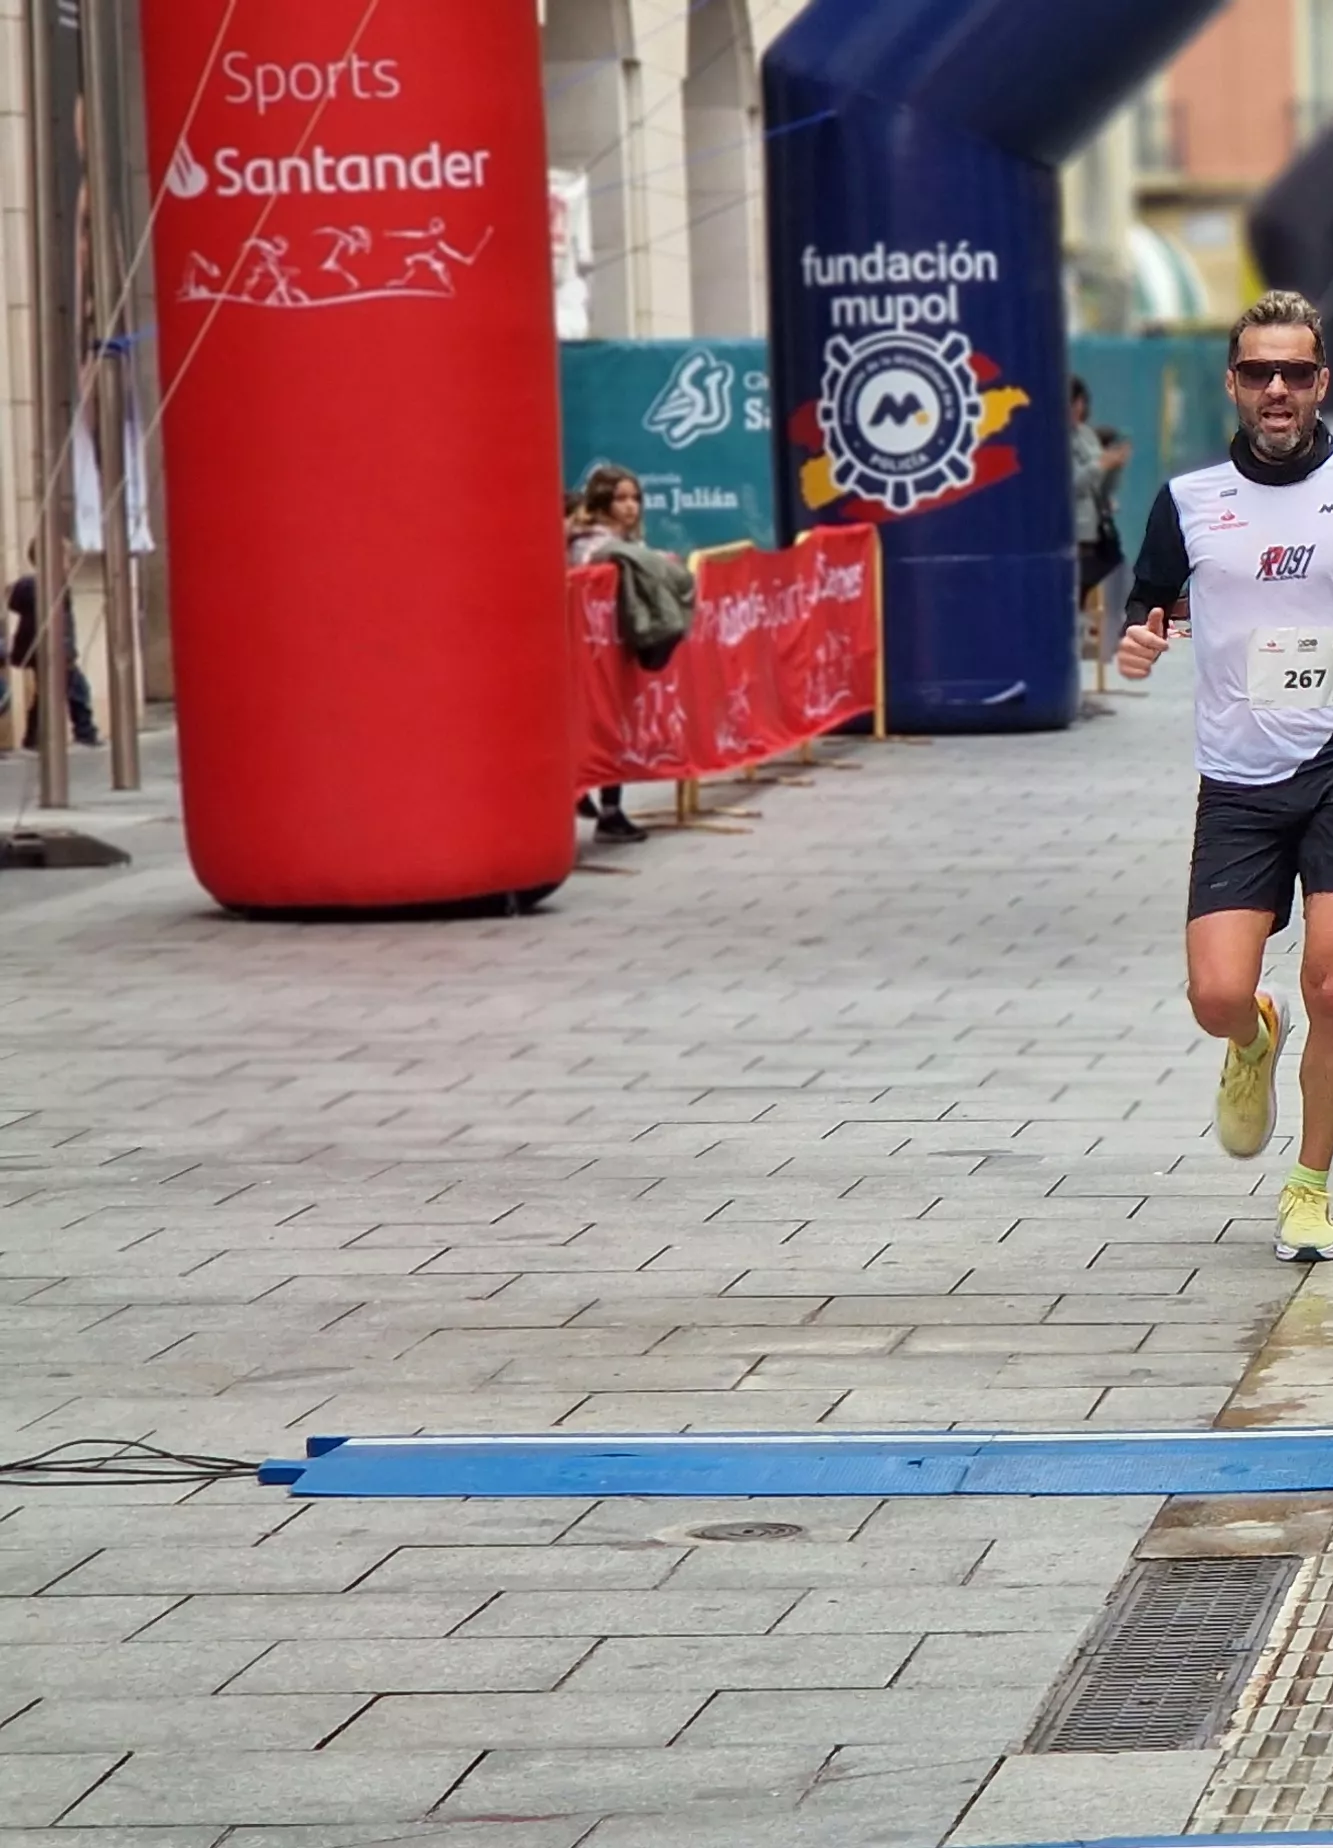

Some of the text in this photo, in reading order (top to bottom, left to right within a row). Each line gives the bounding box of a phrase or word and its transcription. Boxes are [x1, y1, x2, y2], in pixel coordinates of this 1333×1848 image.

[222, 51, 401, 114] Sports
[213, 140, 491, 196] Santander
[802, 240, 998, 285] fundación
[831, 285, 958, 332] mupol
[671, 486, 738, 515] Julián
[1284, 669, 1327, 689] 267
